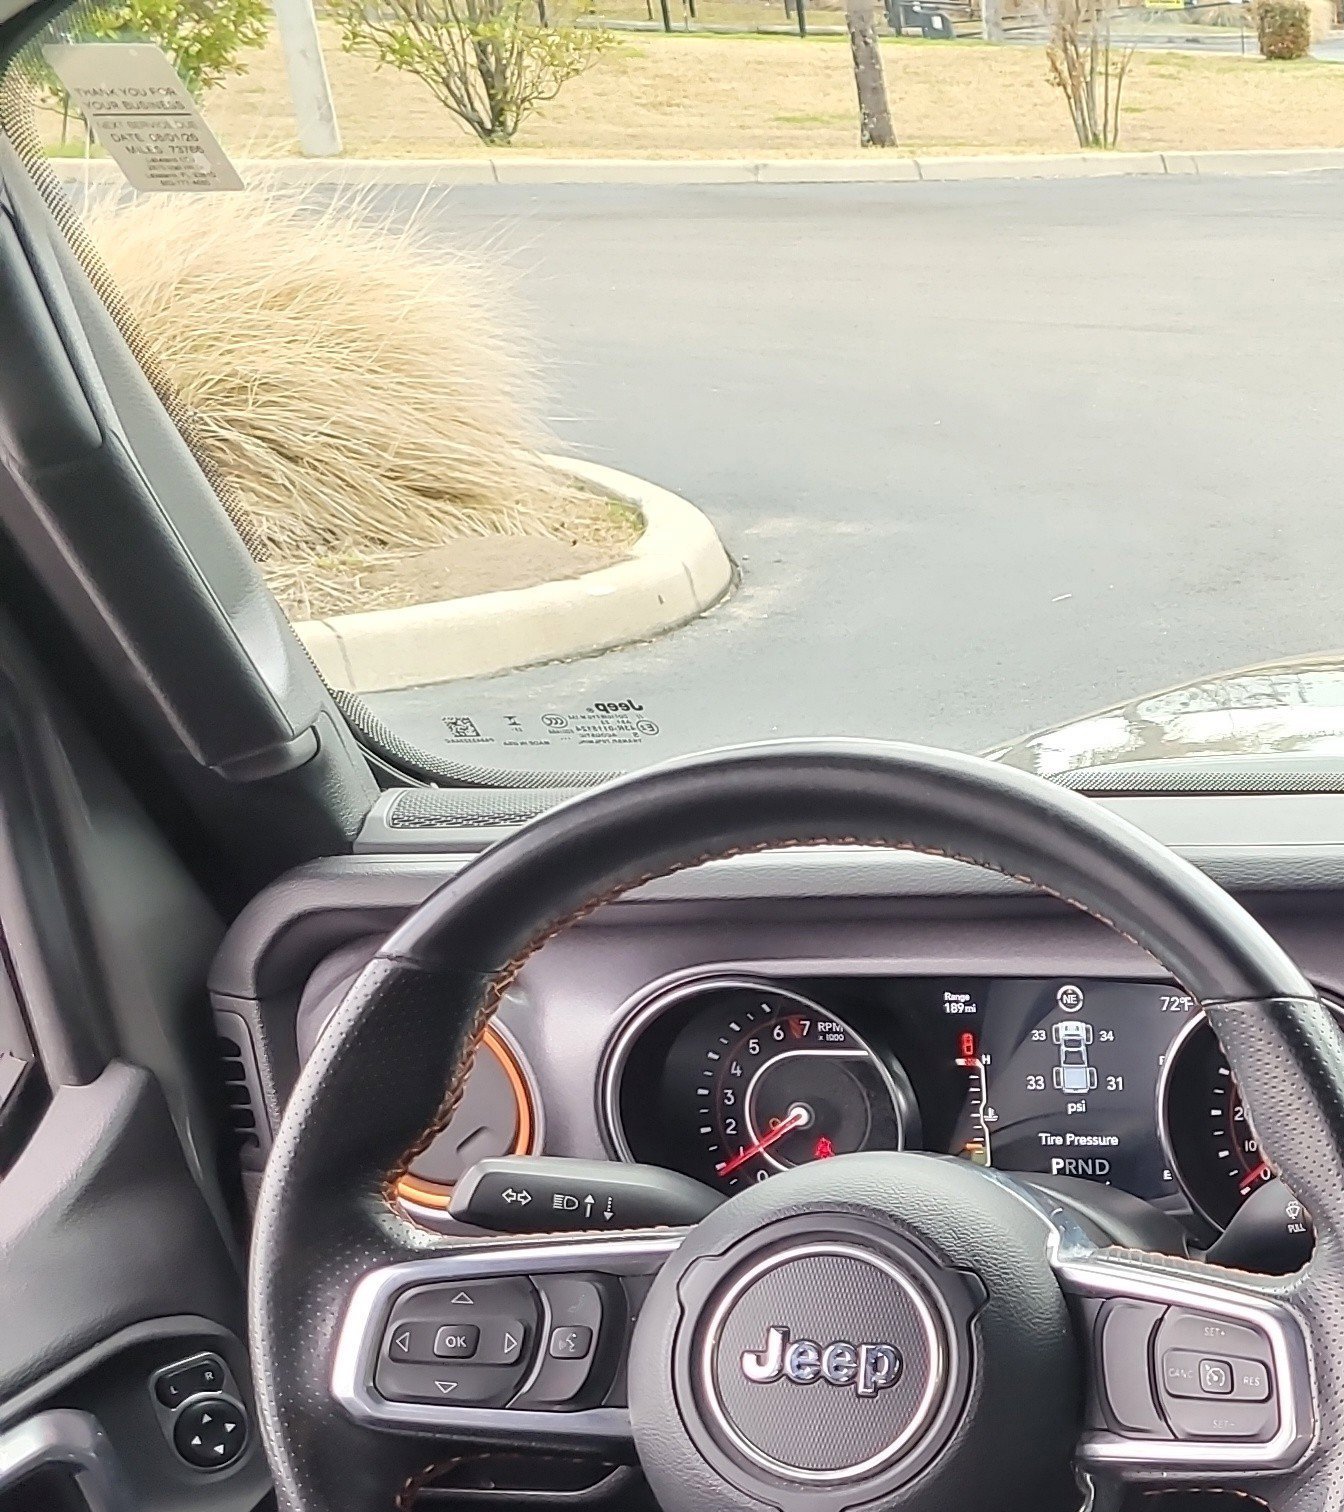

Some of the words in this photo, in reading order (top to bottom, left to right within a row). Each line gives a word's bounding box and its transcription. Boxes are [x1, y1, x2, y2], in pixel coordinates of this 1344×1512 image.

[74, 87, 117, 97] THANK
[119, 87, 147, 97] YOU
[149, 87, 177, 97] FOR
[85, 101, 119, 110] YOUR
[110, 133, 145, 142] DATE
[126, 146, 163, 154] MILES
[943, 992, 971, 1003] Range
[1063, 994, 1077, 1004] NE
[799, 1020, 811, 1036] 7
[817, 1021, 845, 1032] RPM
[773, 1025, 785, 1041] 6
[1030, 1030, 1047, 1041] 33
[1099, 1031, 1115, 1041] 34
[749, 1039, 760, 1055] 5
[981, 1054, 991, 1065] H
[730, 1061, 742, 1077] 4
[1026, 1076, 1045, 1090] 33
[1106, 1076, 1124, 1090] 31
[723, 1089, 735, 1105] 3
[1067, 1100, 1086, 1115] psi
[725, 1119, 737, 1134] 2
[1038, 1133, 1063, 1146] Tire
[1066, 1133, 1119, 1146] Pressure
[1244, 1141, 1257, 1152] 10
[1051, 1158, 1110, 1175] PRND
[1163, 1170, 1172, 1180] E
[1260, 1168, 1270, 1180] 0
[1287, 1222, 1307, 1234] PULL
[445, 1336, 467, 1348] OK
[740, 1325, 903, 1398] Jeep
[204, 1371, 214, 1380] R
[1243, 1376, 1261, 1387] RES
[169, 1385, 179, 1395] L
